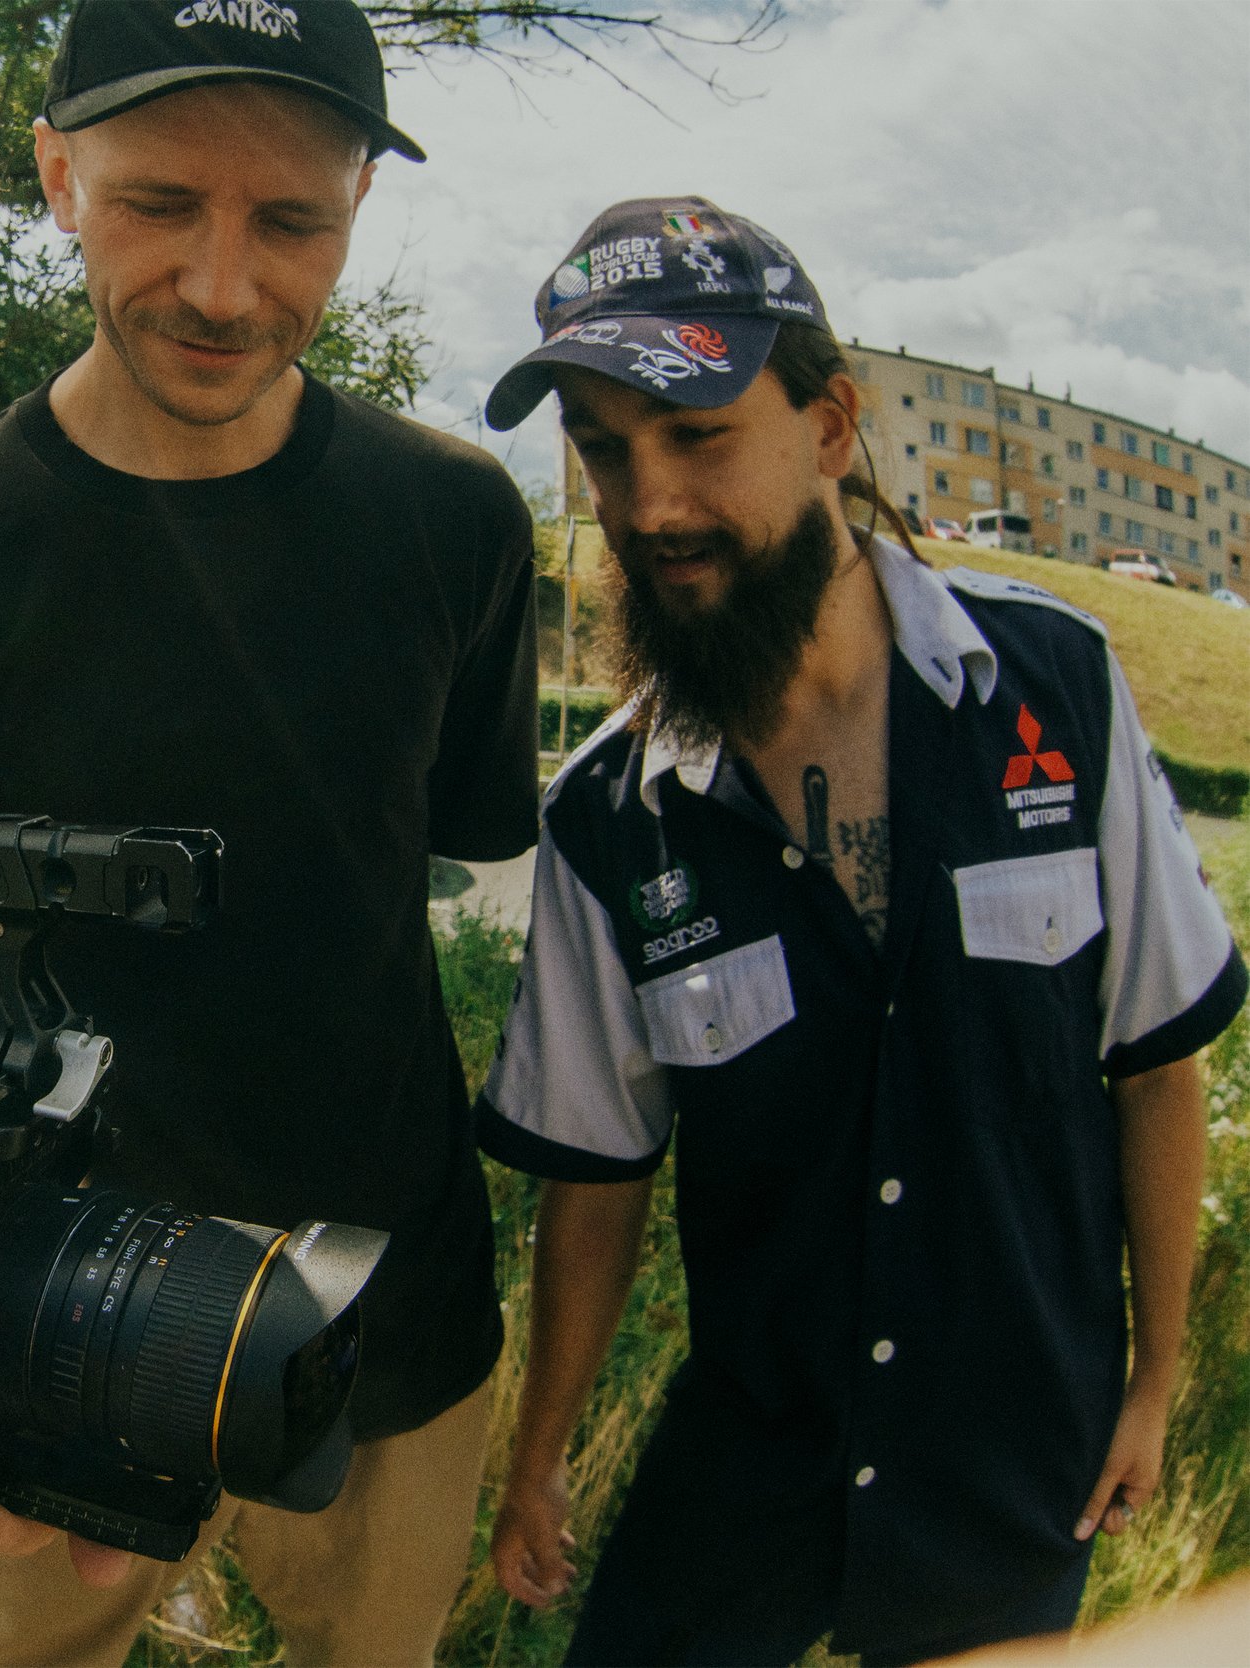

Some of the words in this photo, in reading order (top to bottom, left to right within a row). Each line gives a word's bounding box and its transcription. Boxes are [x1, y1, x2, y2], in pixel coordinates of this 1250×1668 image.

[588, 236, 661, 265] RUGBY
[590, 253, 632, 275] WORLD
[633, 251, 661, 263] CUP
[589, 261, 663, 291] 2015
[1005, 783, 1075, 810] MITSUBISHI
[1018, 805, 1071, 829] MOTORS
[643, 916, 717, 958] sparco
[101, 1295, 115, 1312] CS
